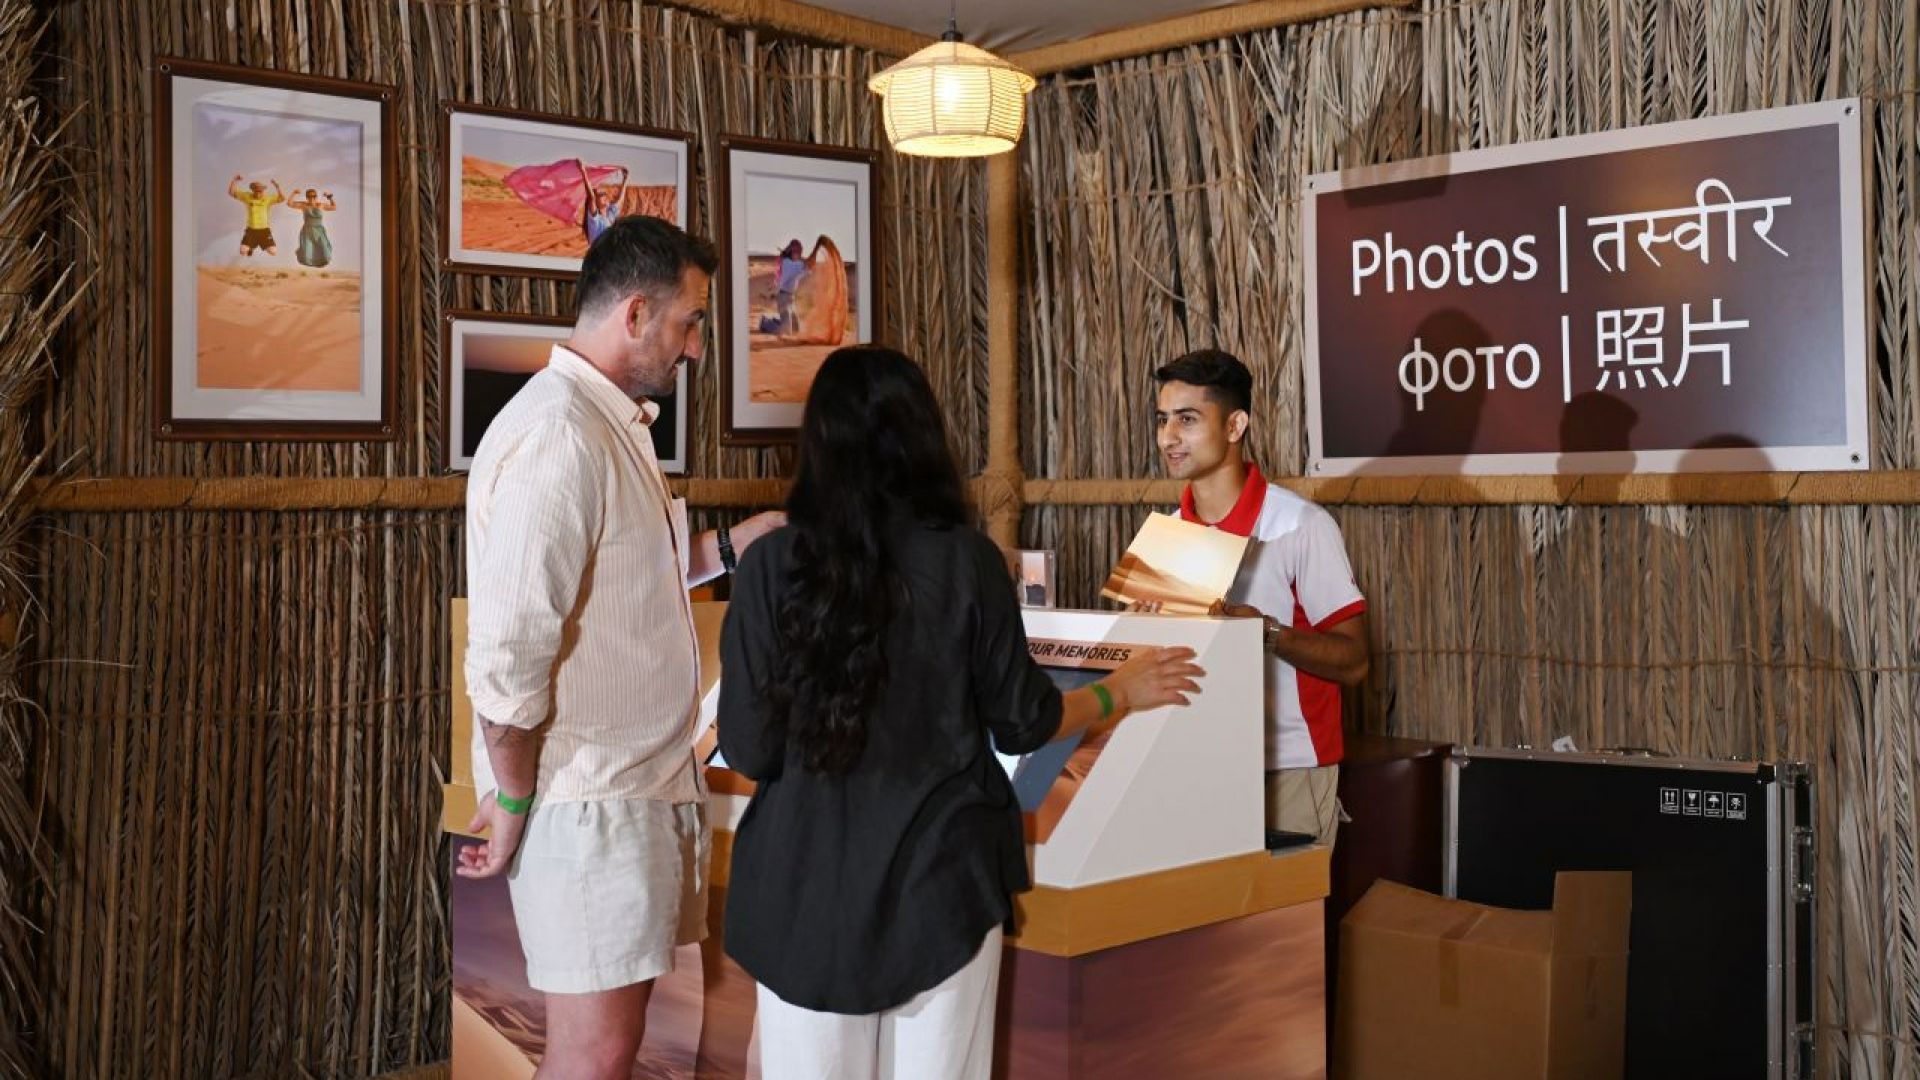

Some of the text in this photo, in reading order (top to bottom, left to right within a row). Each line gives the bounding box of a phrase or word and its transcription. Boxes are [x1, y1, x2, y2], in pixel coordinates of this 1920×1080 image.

[1587, 178, 1792, 272] तस्वीर
[1352, 231, 1538, 297] Photos
[1398, 337, 1541, 412] фото
[1595, 298, 1750, 391] 照片
[1054, 644, 1132, 661] MEMORIES
